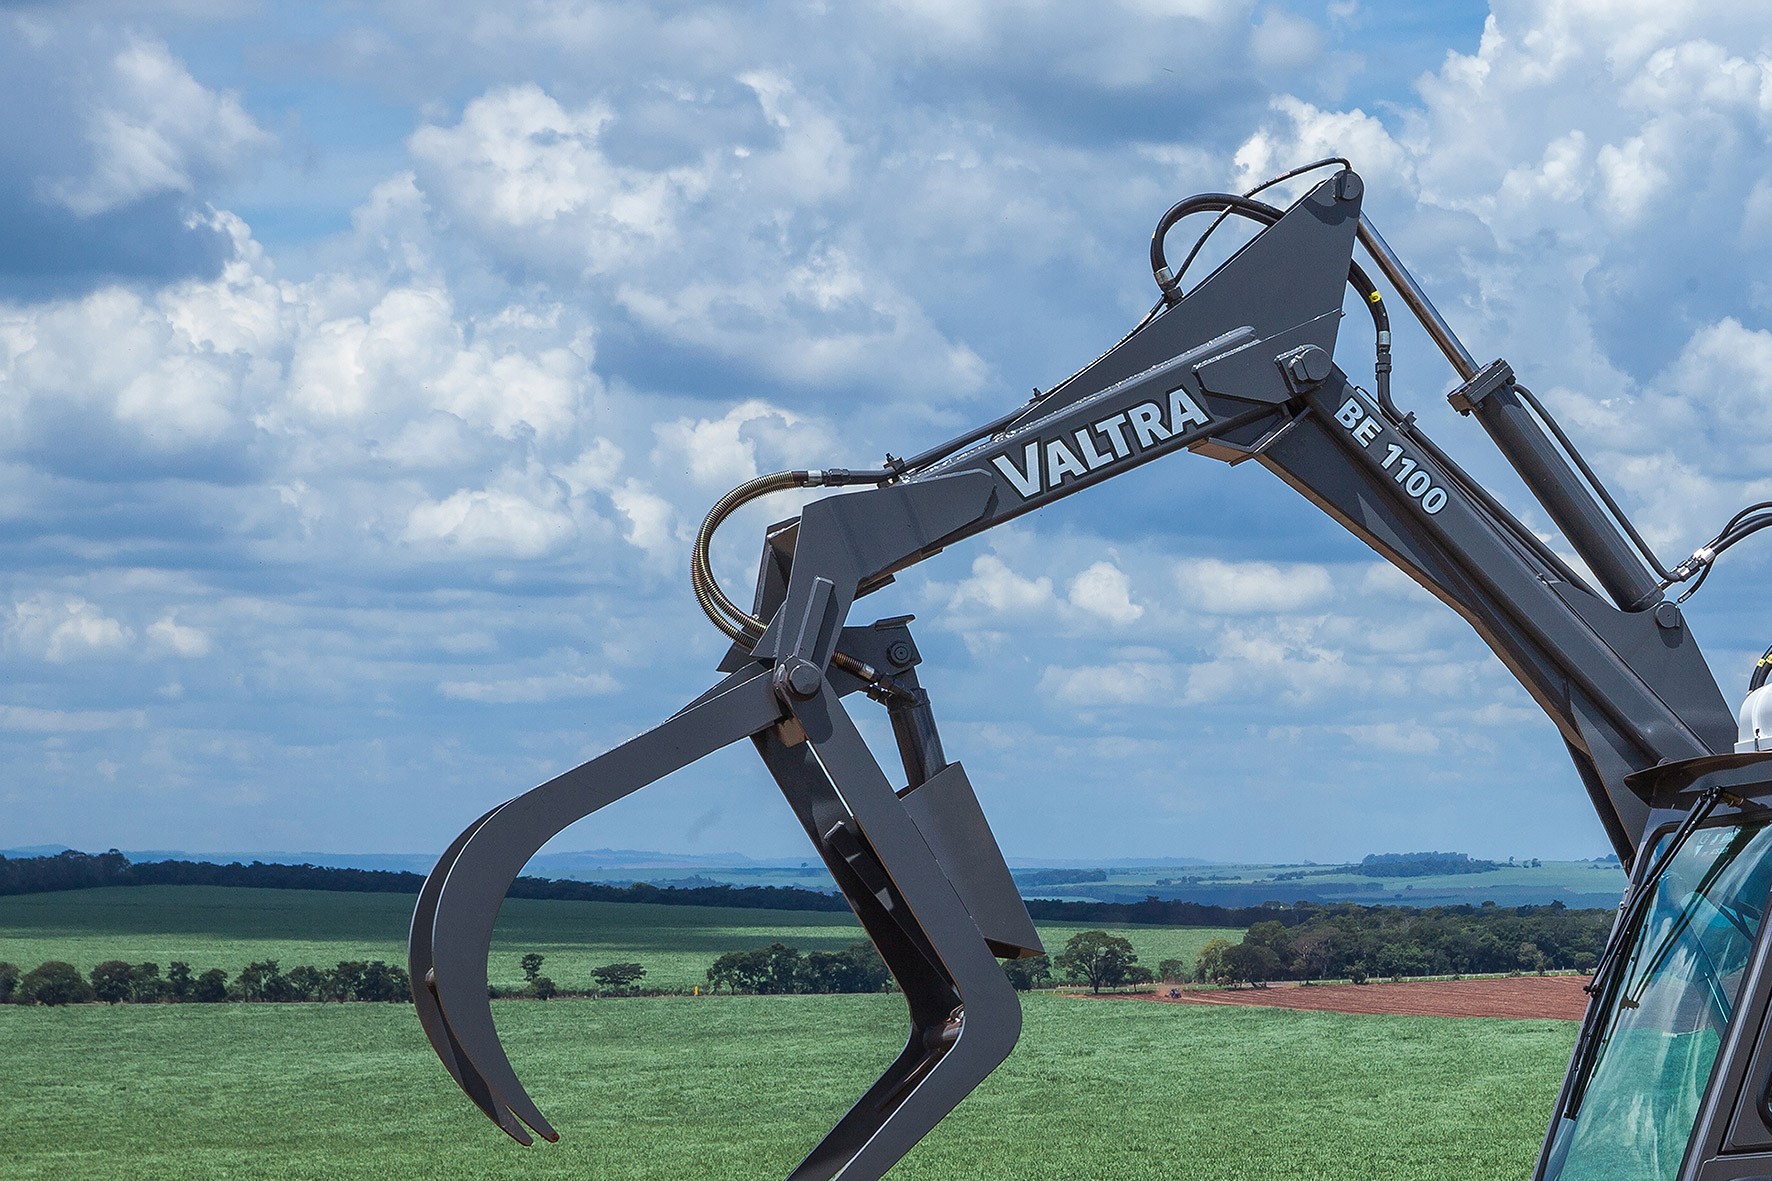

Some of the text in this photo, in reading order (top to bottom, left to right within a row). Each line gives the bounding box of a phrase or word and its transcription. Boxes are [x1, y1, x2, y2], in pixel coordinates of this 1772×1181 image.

[990, 386, 1211, 499] VALTRA
[1333, 397, 1448, 515] BE 1100
